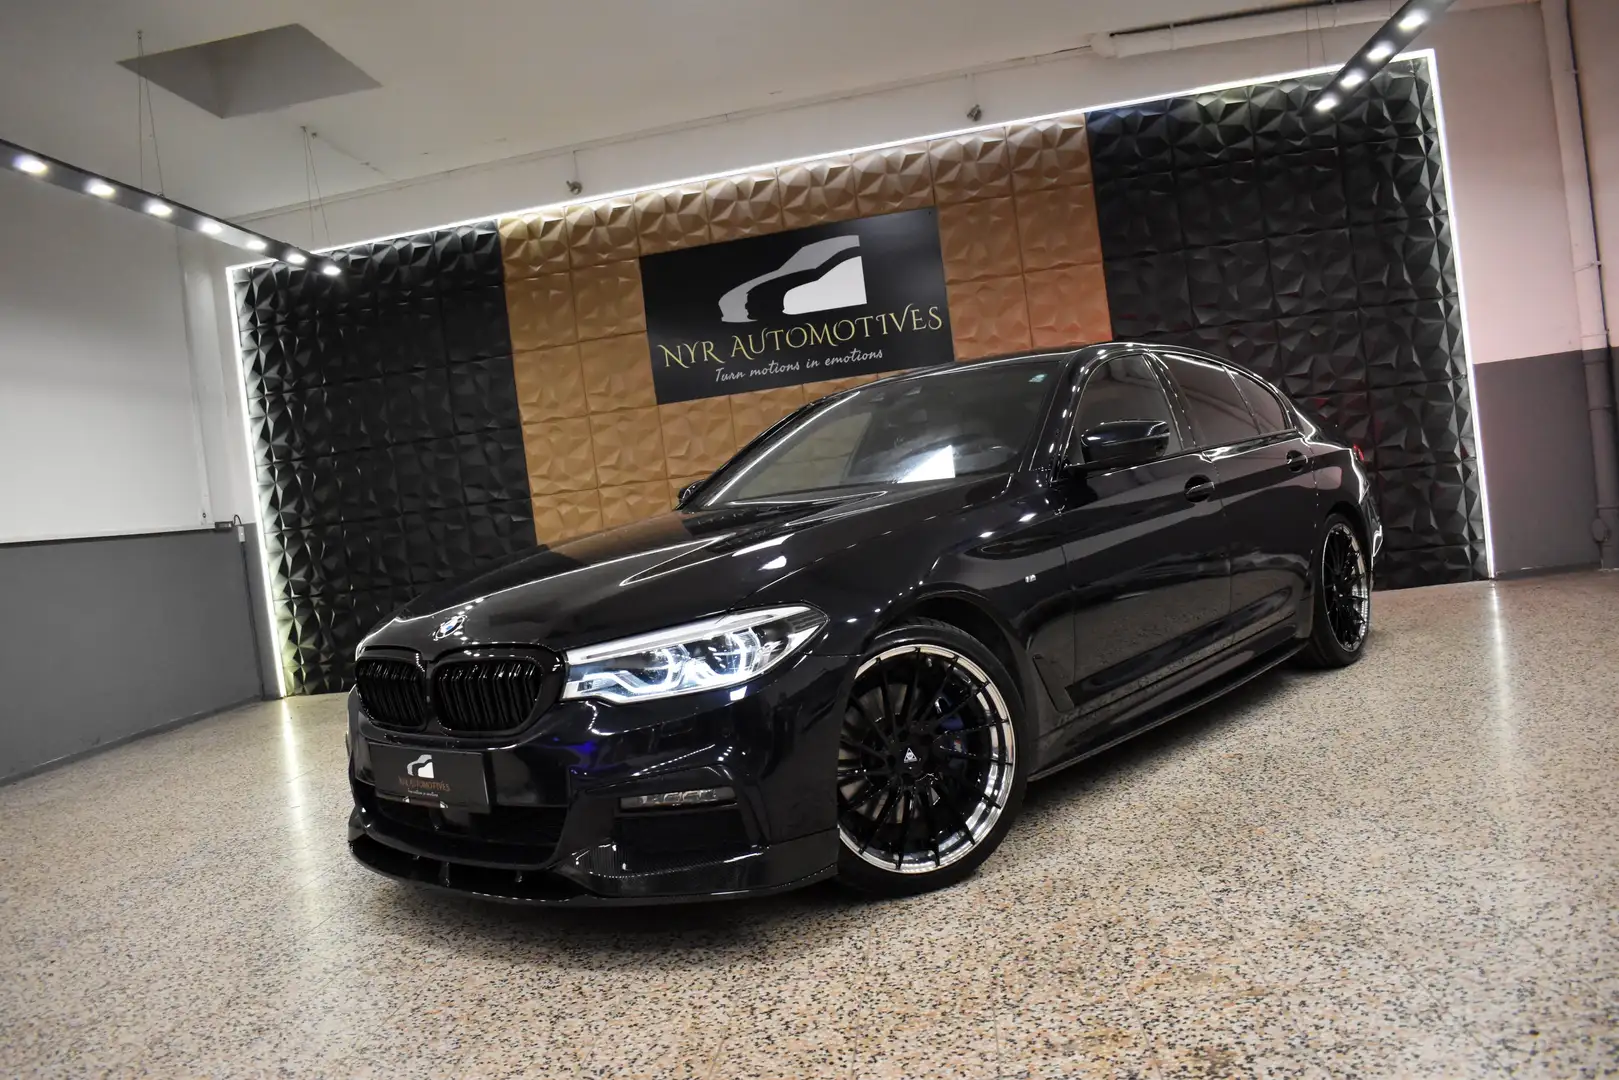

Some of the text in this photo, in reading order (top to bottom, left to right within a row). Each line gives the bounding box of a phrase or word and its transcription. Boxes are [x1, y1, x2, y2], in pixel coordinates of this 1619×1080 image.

[659, 303, 942, 368] NYR AUTOMOTIVES
[714, 347, 883, 383] Turn motions in emotions
